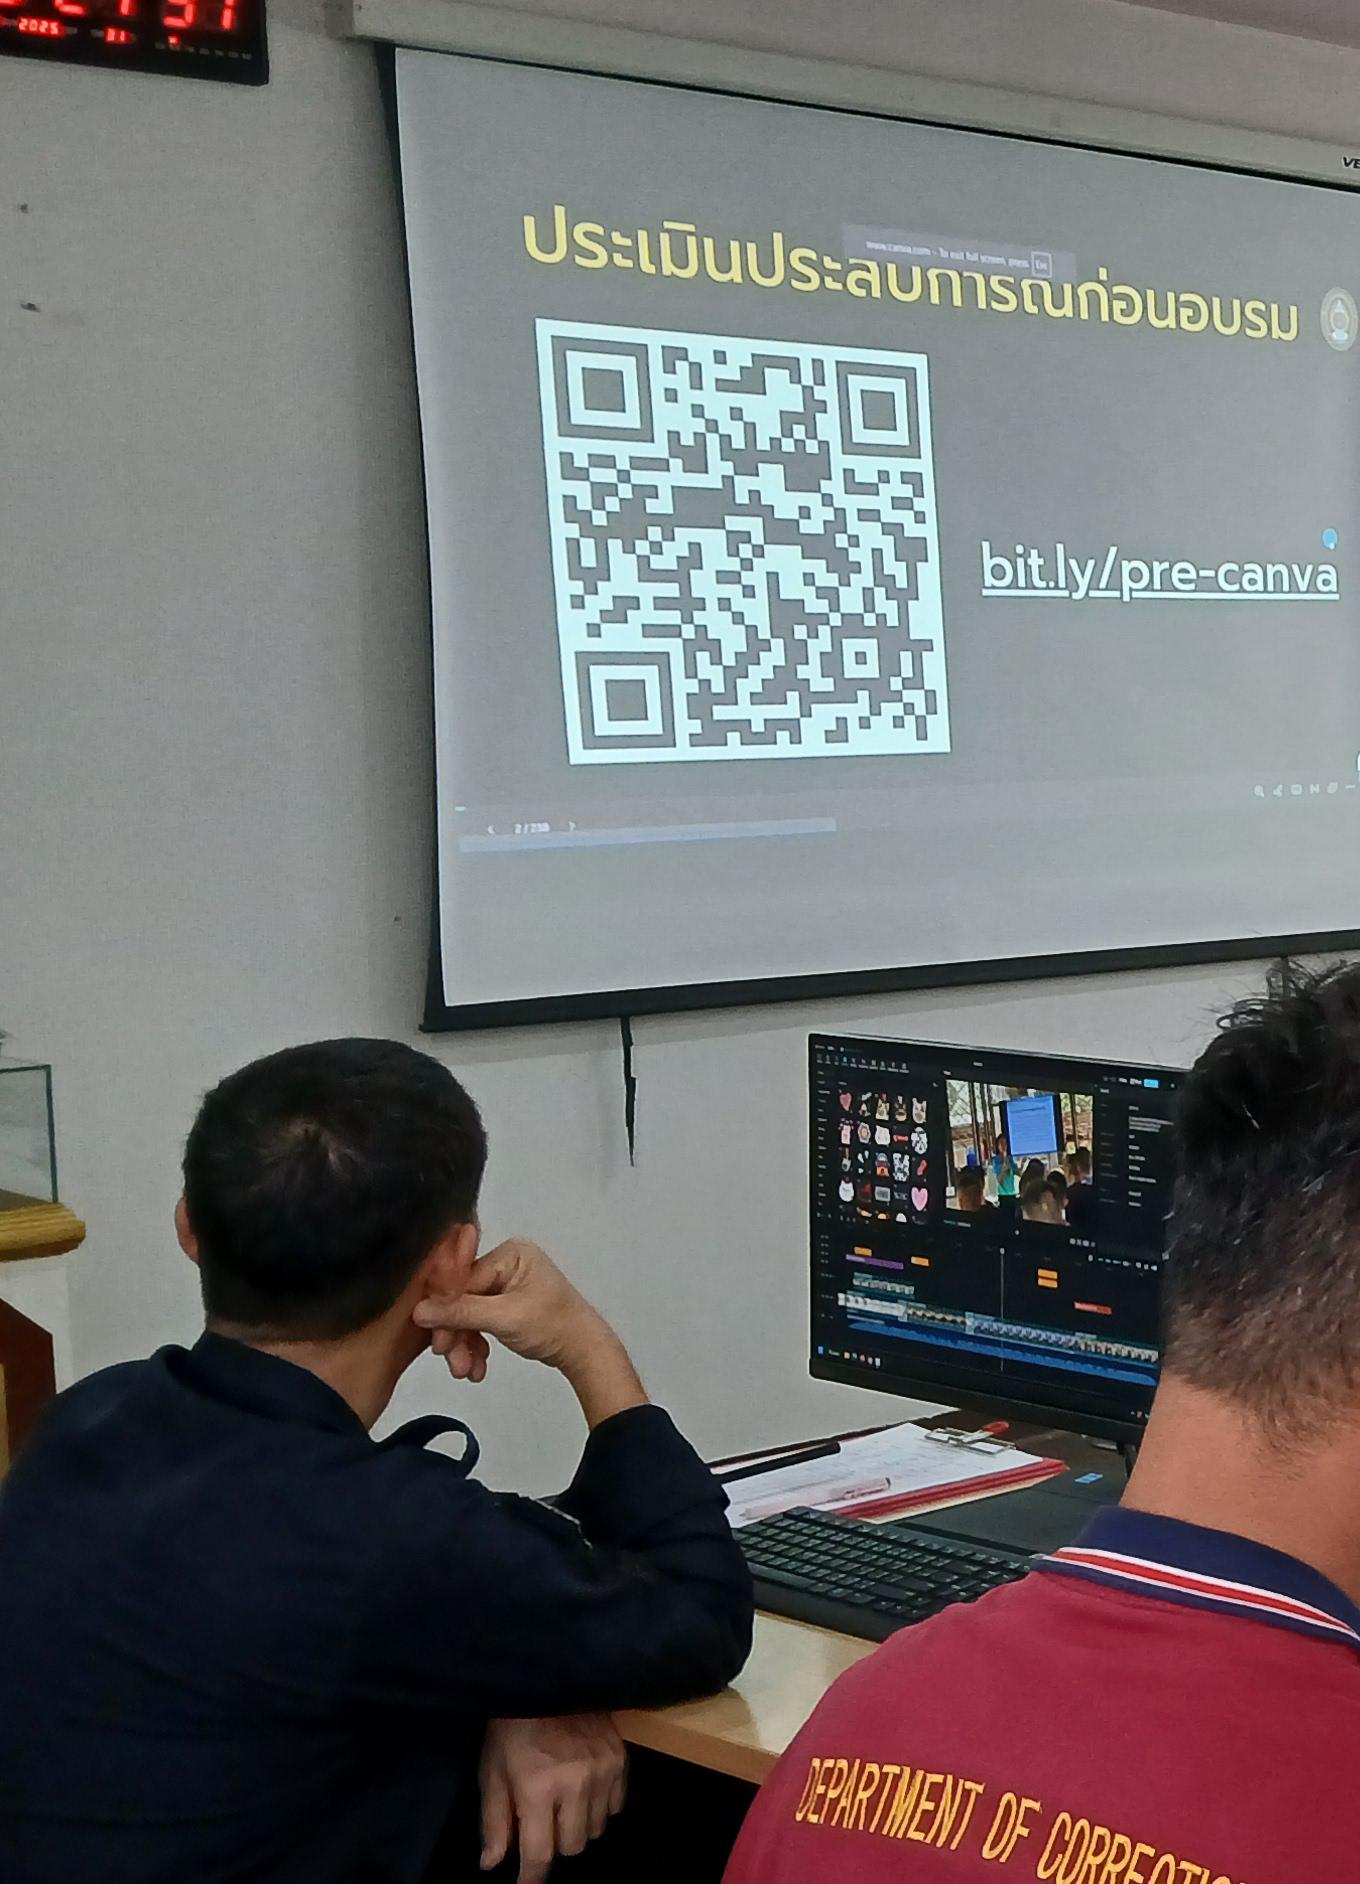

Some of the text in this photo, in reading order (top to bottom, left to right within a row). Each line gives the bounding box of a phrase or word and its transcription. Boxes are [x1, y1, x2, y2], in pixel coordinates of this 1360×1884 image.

[18, 18, 59, 36] 2025
[523, 204, 1300, 342] ประเมินประสบการณก่อนอบรม
[981, 540, 1340, 601] bit.ly/pre-canva
[794, 1757, 985, 1851] DEPARTMENT
[981, 1791, 1042, 1863] OF
